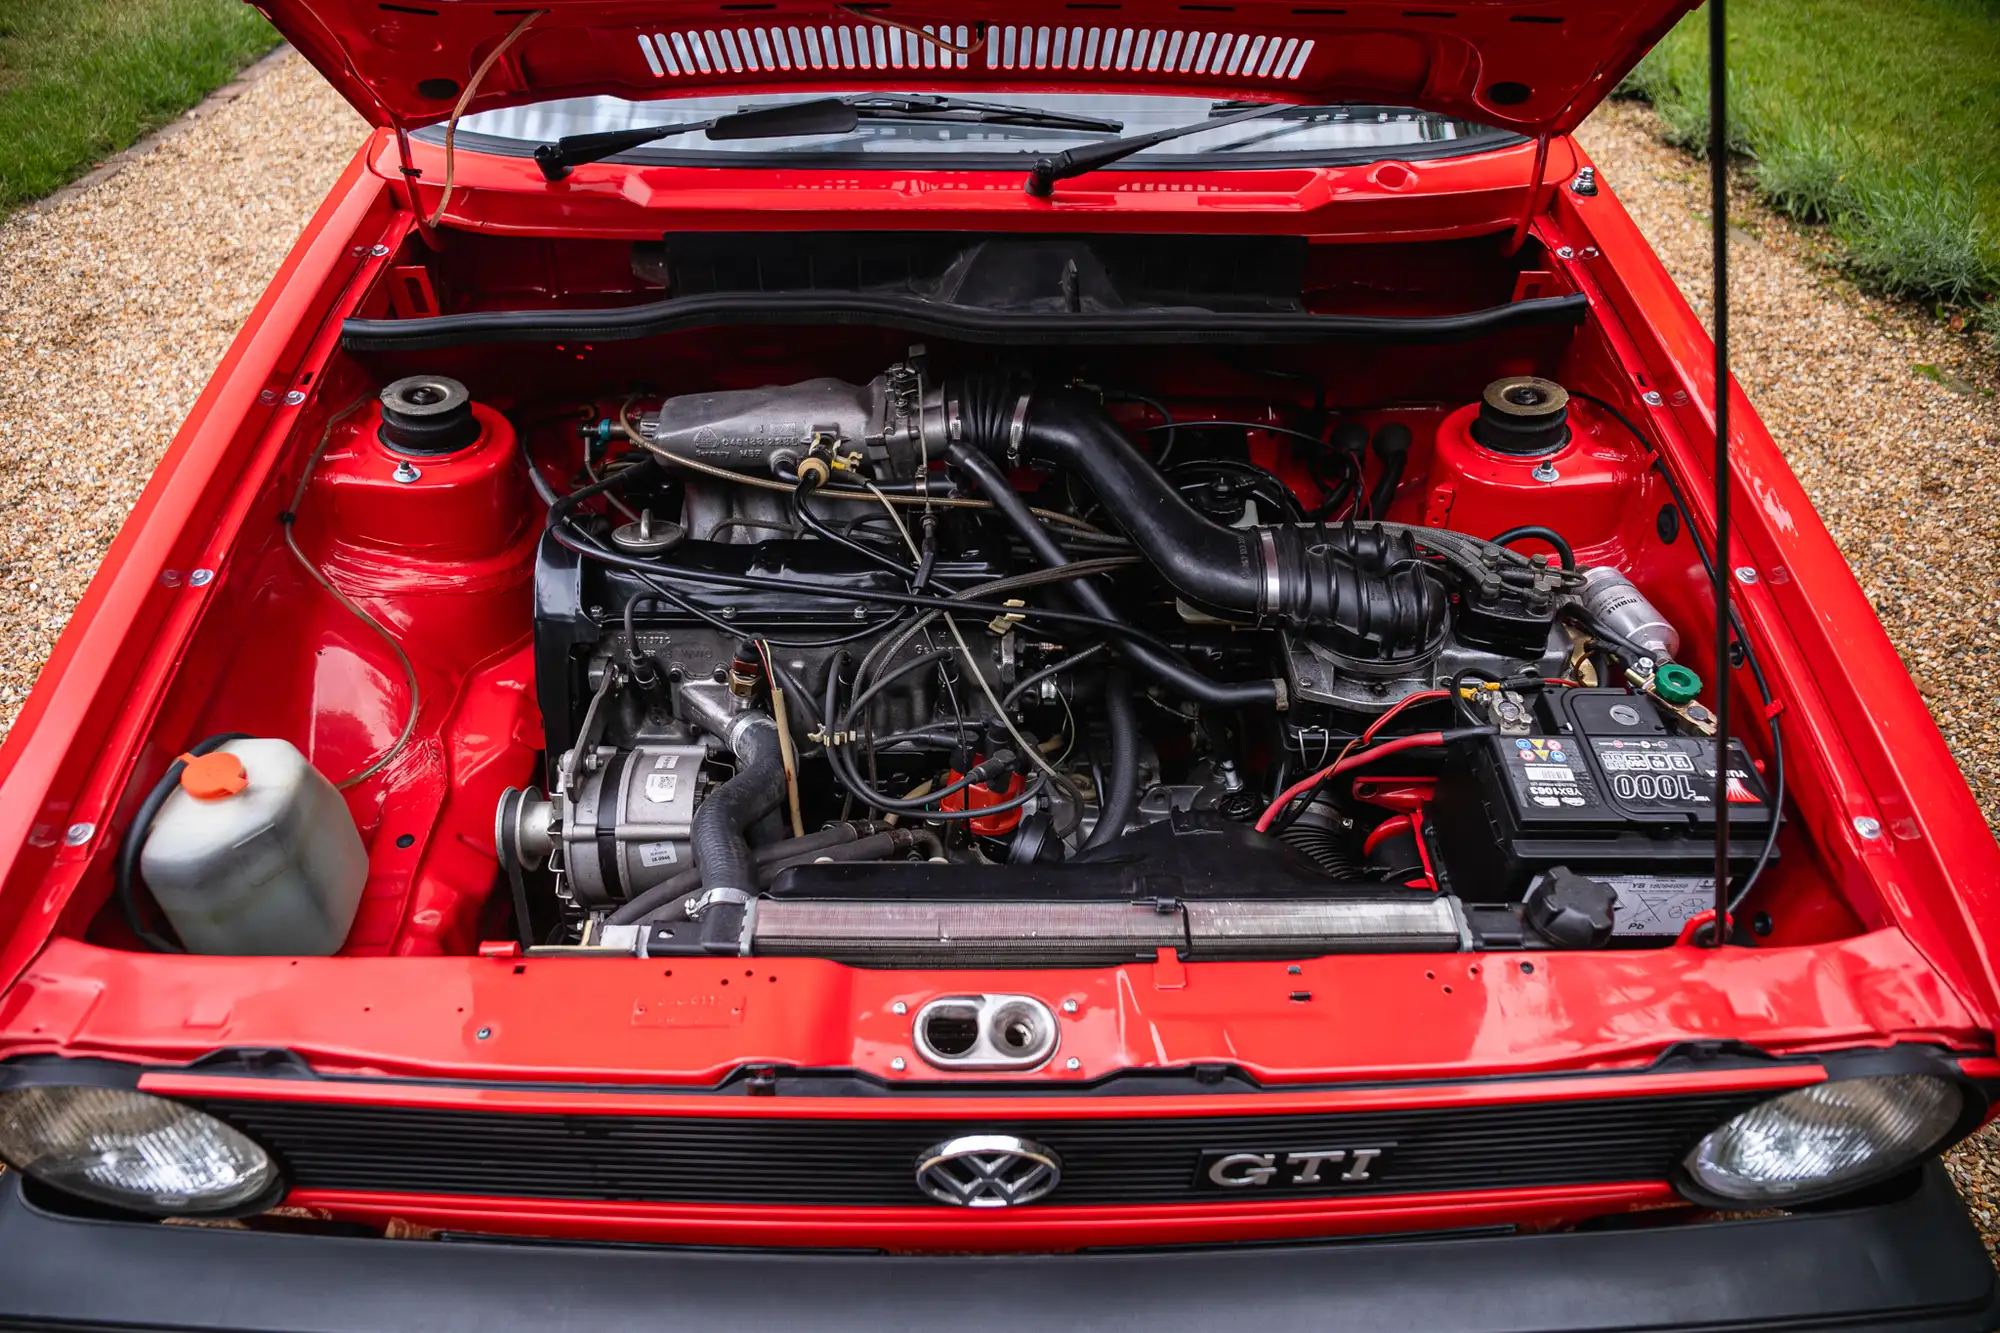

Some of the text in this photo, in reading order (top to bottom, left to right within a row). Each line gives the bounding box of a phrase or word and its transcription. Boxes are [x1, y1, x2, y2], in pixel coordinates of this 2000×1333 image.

[1605, 597, 1638, 615] MAHLE
[1613, 774, 1696, 799] 1000
[1627, 922, 1645, 930] Pb
[919, 1140, 1059, 1207] VW
[1208, 1148, 1381, 1187] GTI
